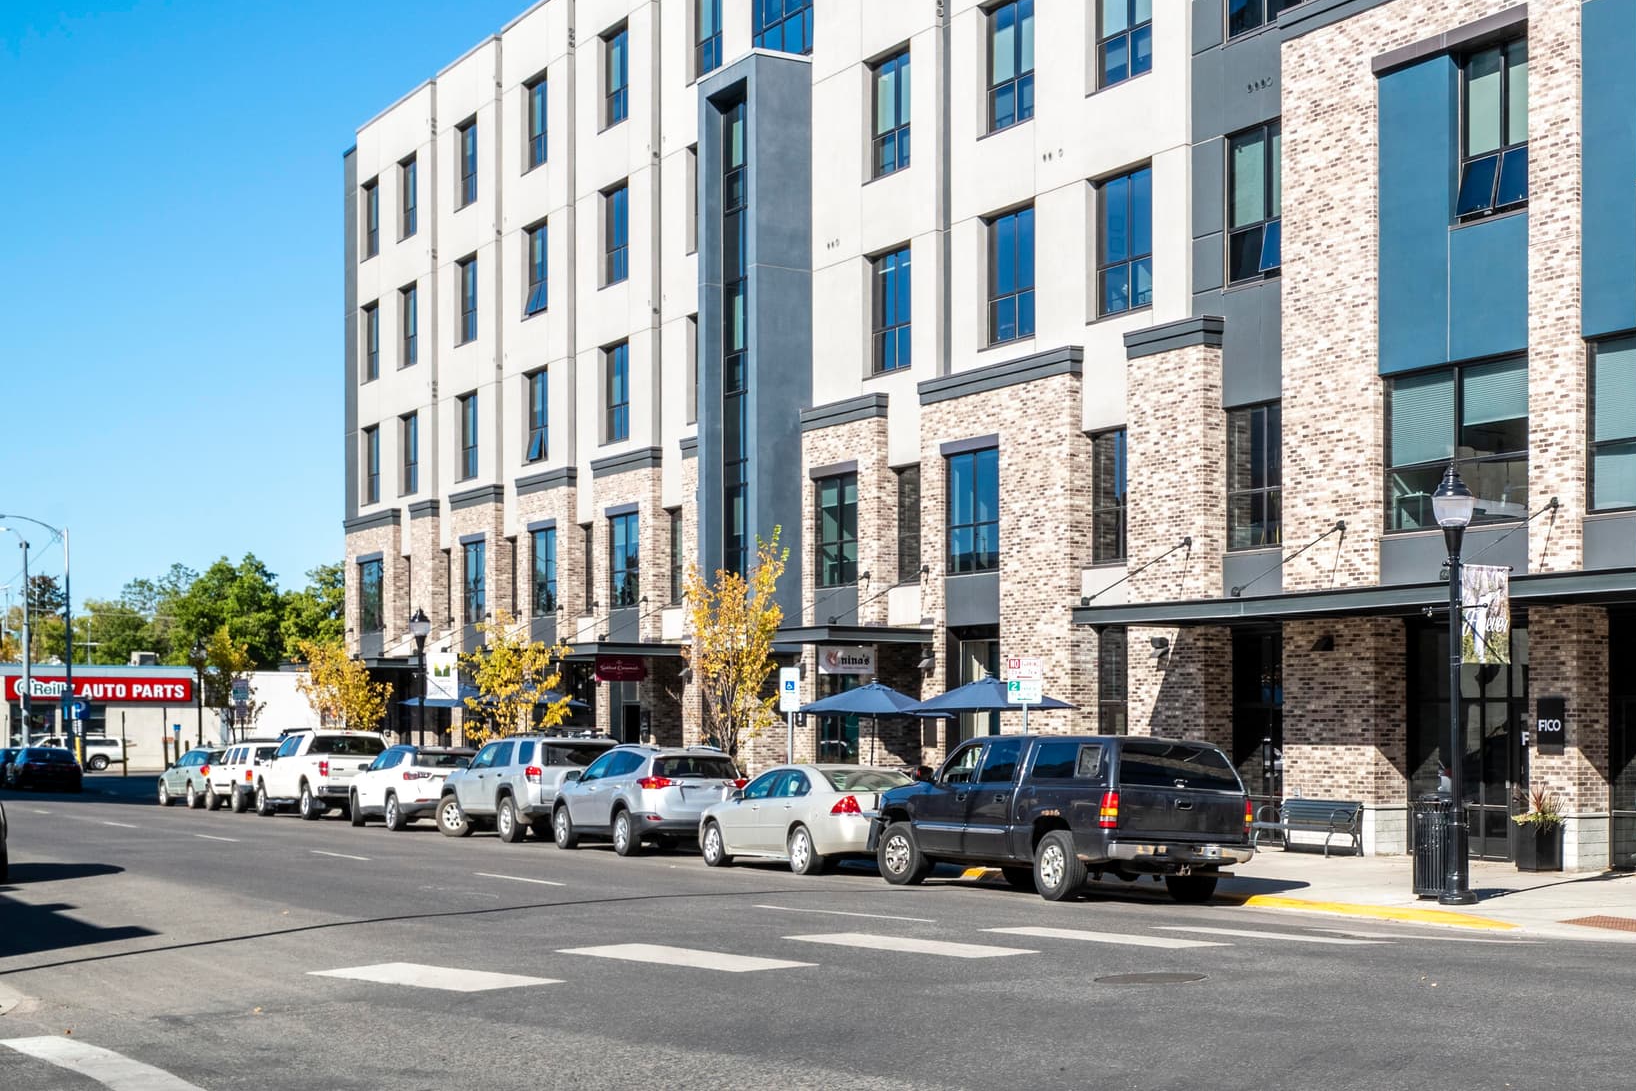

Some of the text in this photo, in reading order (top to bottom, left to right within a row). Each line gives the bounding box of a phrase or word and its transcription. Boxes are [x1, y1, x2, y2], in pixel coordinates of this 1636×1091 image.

[1010, 659, 1020, 668] NO
[14, 678, 185, 698] O'Reill AUTO PARTS
[1010, 681, 1019, 691] 2
[1538, 719, 1562, 732] FICO
